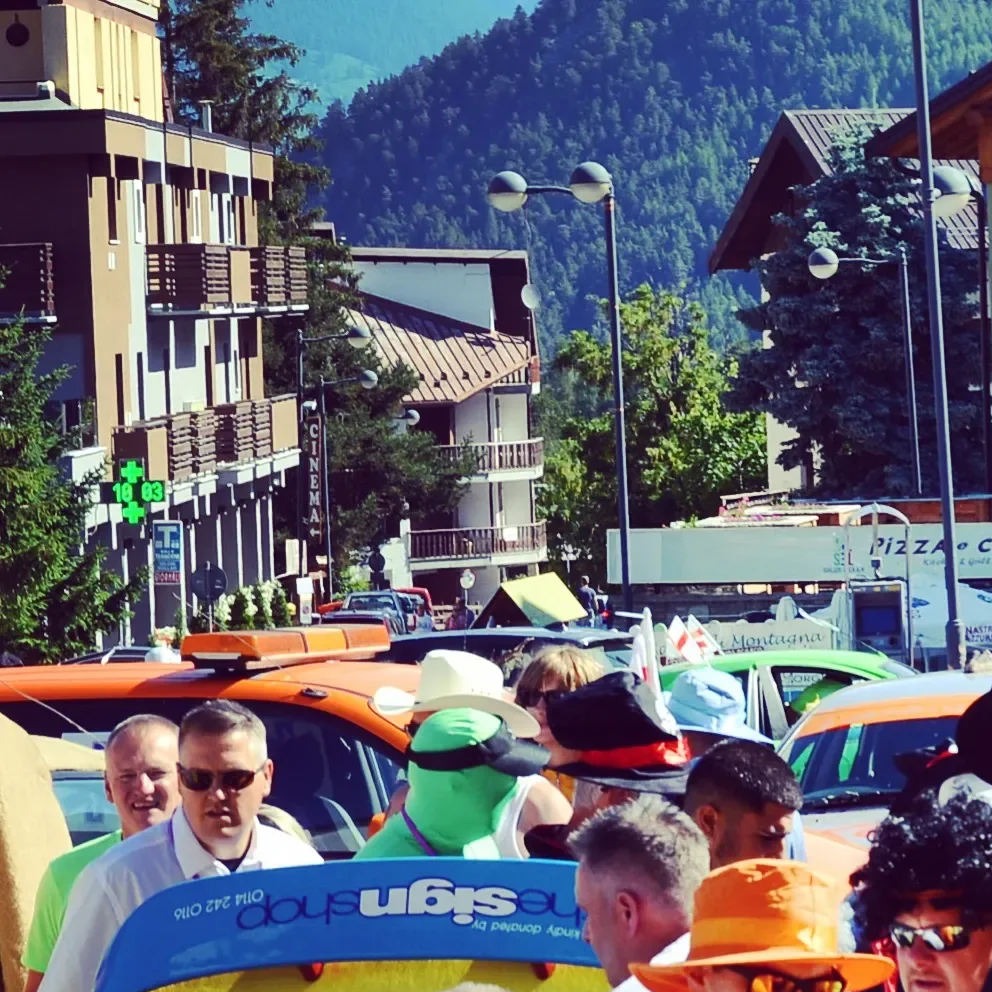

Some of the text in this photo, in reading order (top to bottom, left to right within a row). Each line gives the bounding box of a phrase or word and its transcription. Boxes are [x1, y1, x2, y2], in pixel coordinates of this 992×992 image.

[309, 423, 320, 523] CINEMA
[732, 632, 823, 649] Montagna
[174, 888, 264, 921] 0114 242 0116
[471, 917, 581, 940] kindly donated by
